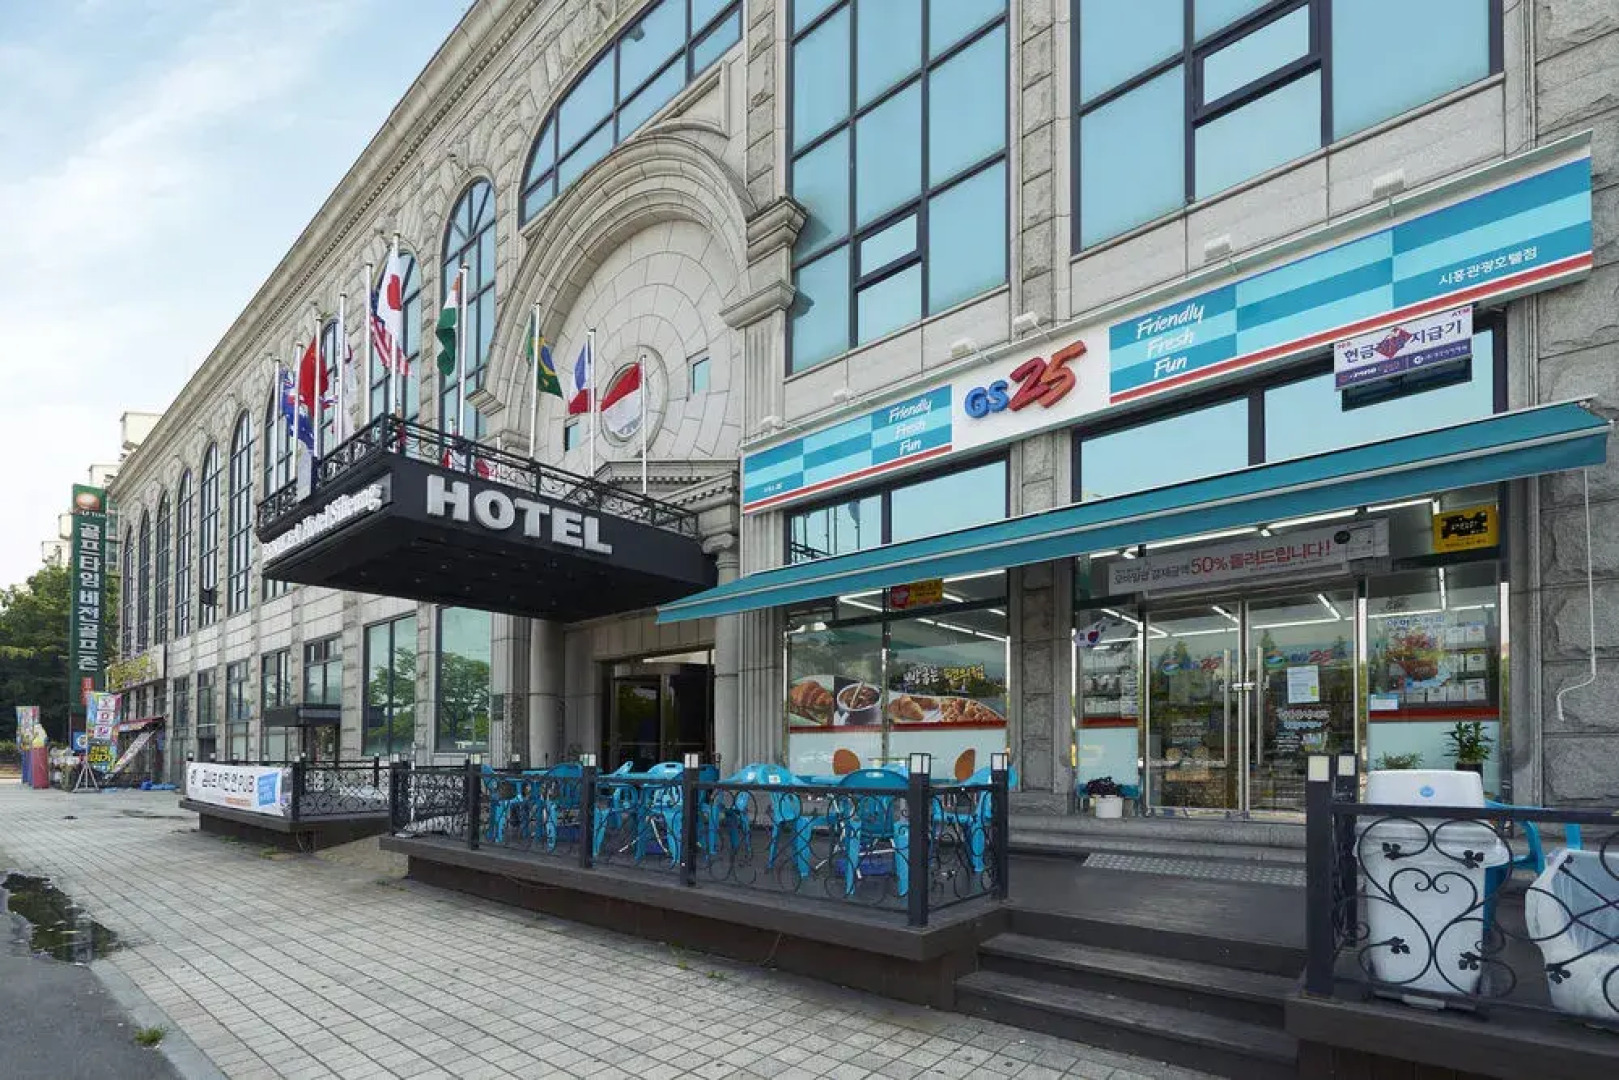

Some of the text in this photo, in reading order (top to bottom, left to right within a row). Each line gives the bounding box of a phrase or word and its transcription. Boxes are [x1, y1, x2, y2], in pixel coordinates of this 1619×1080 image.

[1136, 303, 1206, 339] Friendly
[1411, 319, 1462, 344] 지급기
[1147, 327, 1195, 359] Fresh
[964, 340, 1087, 419] GS25
[1153, 356, 1188, 378] Fun
[888, 398, 933, 423] Friendly
[899, 439, 922, 455] Fun
[426, 474, 613, 555] HOTEL
[1191, 556, 1228, 575] 50%
